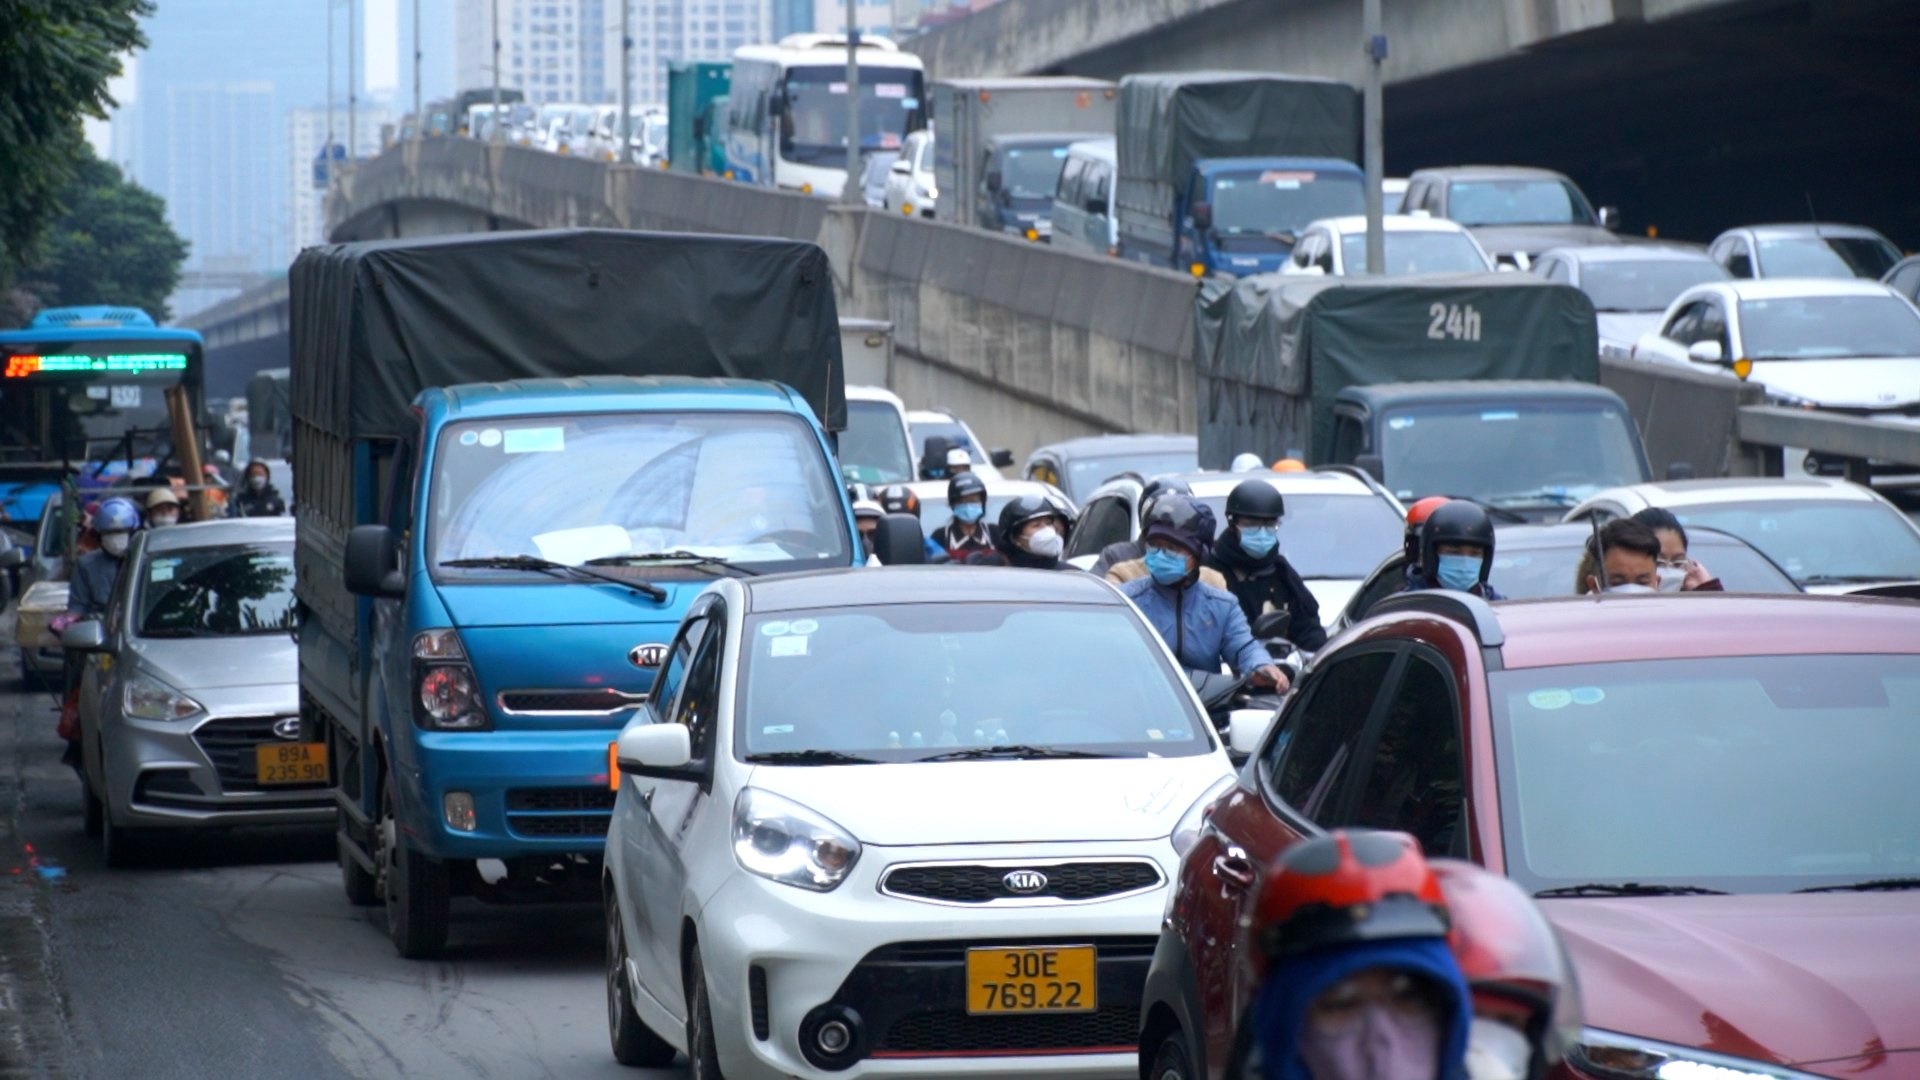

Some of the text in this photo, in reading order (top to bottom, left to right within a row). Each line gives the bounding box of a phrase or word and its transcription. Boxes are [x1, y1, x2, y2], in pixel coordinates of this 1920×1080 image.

[1427, 302, 1482, 342] 24h
[278, 747, 310, 762] 89A
[1009, 873, 1041, 889] KIA
[1004, 951, 1059, 978] 30E
[981, 981, 1082, 1010] 769.22
